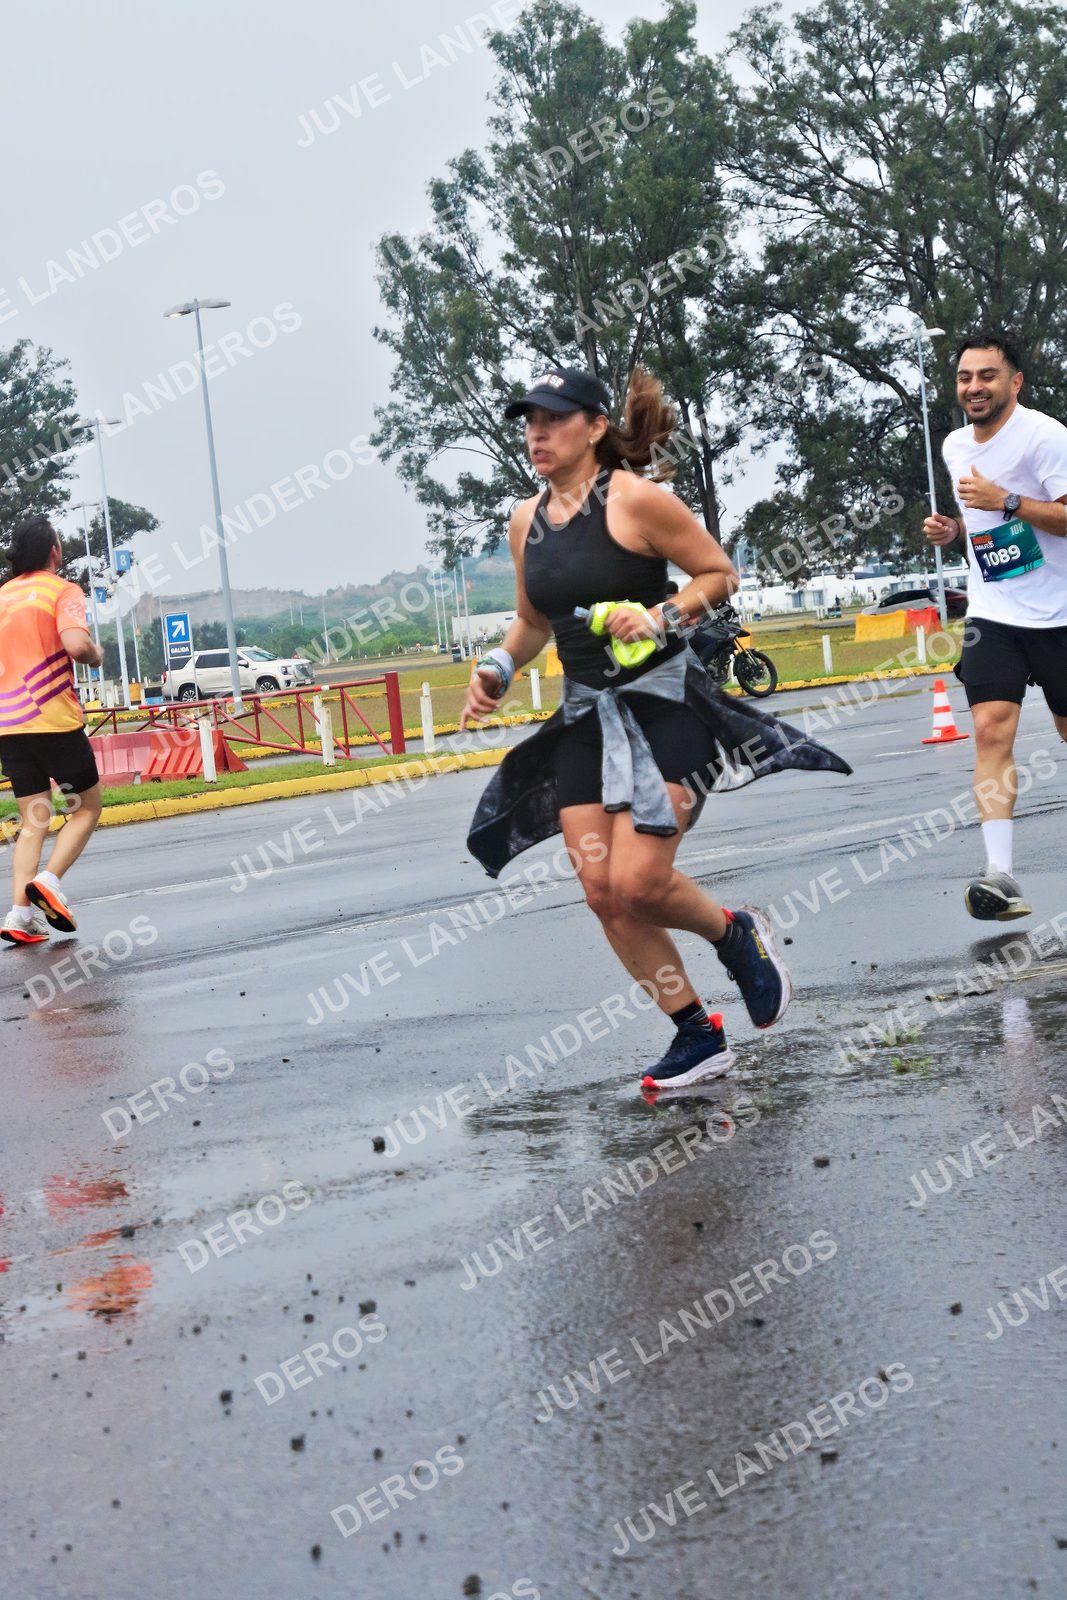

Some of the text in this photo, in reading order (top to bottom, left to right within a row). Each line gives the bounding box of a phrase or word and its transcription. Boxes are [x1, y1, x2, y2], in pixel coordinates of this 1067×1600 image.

[1010, 522, 1024, 535] 10K
[120, 554, 127, 566] 8
[983, 545, 1021, 567] 1089
[170, 646, 190, 654] SALIDA
